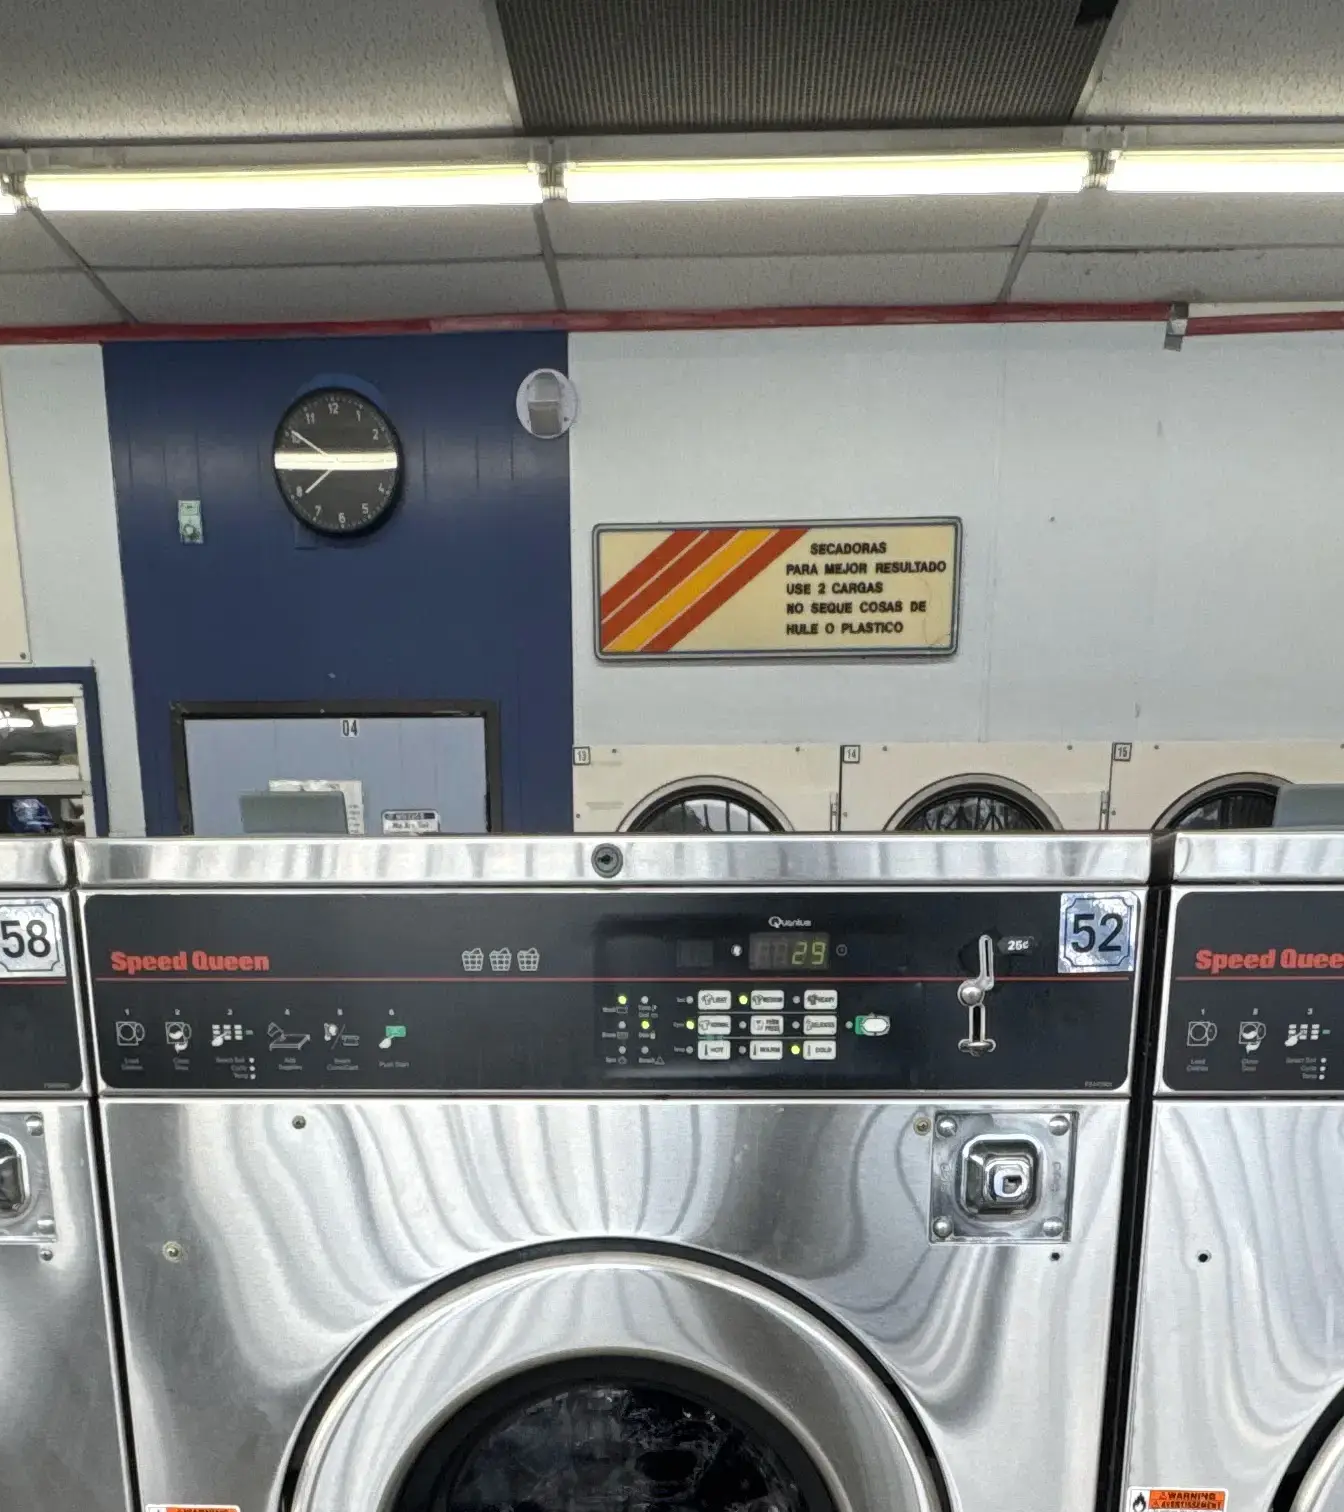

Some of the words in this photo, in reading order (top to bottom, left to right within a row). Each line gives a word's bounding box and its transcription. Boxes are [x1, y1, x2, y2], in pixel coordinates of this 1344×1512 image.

[328, 403, 340, 415] 12
[306, 413, 315, 425] 11
[373, 429, 380, 440] 2
[362, 503, 369, 514] 5
[338, 513, 346, 524] 6
[811, 542, 887, 556] SECADORAS
[786, 564, 818, 576] PARA
[825, 563, 868, 575] MEJOR
[876, 561, 947, 574] RESULTADO
[786, 583, 811, 595] USE
[818, 583, 826, 595] 2
[832, 582, 884, 594] CARGAS
[786, 603, 804, 614] NO
[811, 602, 853, 614] SEQUE
[860, 601, 903, 613] COSAS
[910, 601, 927, 612] DE
[786, 624, 819, 636] HULE
[825, 623, 835, 634] O
[841, 622, 904, 635] PLASTICO
[342, 720, 358, 736] 04
[577, 749, 587, 761] 13
[1118, 746, 1128, 758] 15
[0, 919, 52, 958] 58
[1071, 912, 1124, 953] 52
[1008, 938, 1029, 951] 25¢
[791, 941, 826, 965] 29
[111, 950, 187, 974] Speed
[192, 950, 270, 972] Queen
[1195, 949, 1276, 974] Speed
[1168, 1492, 1216, 1501] WARNING
